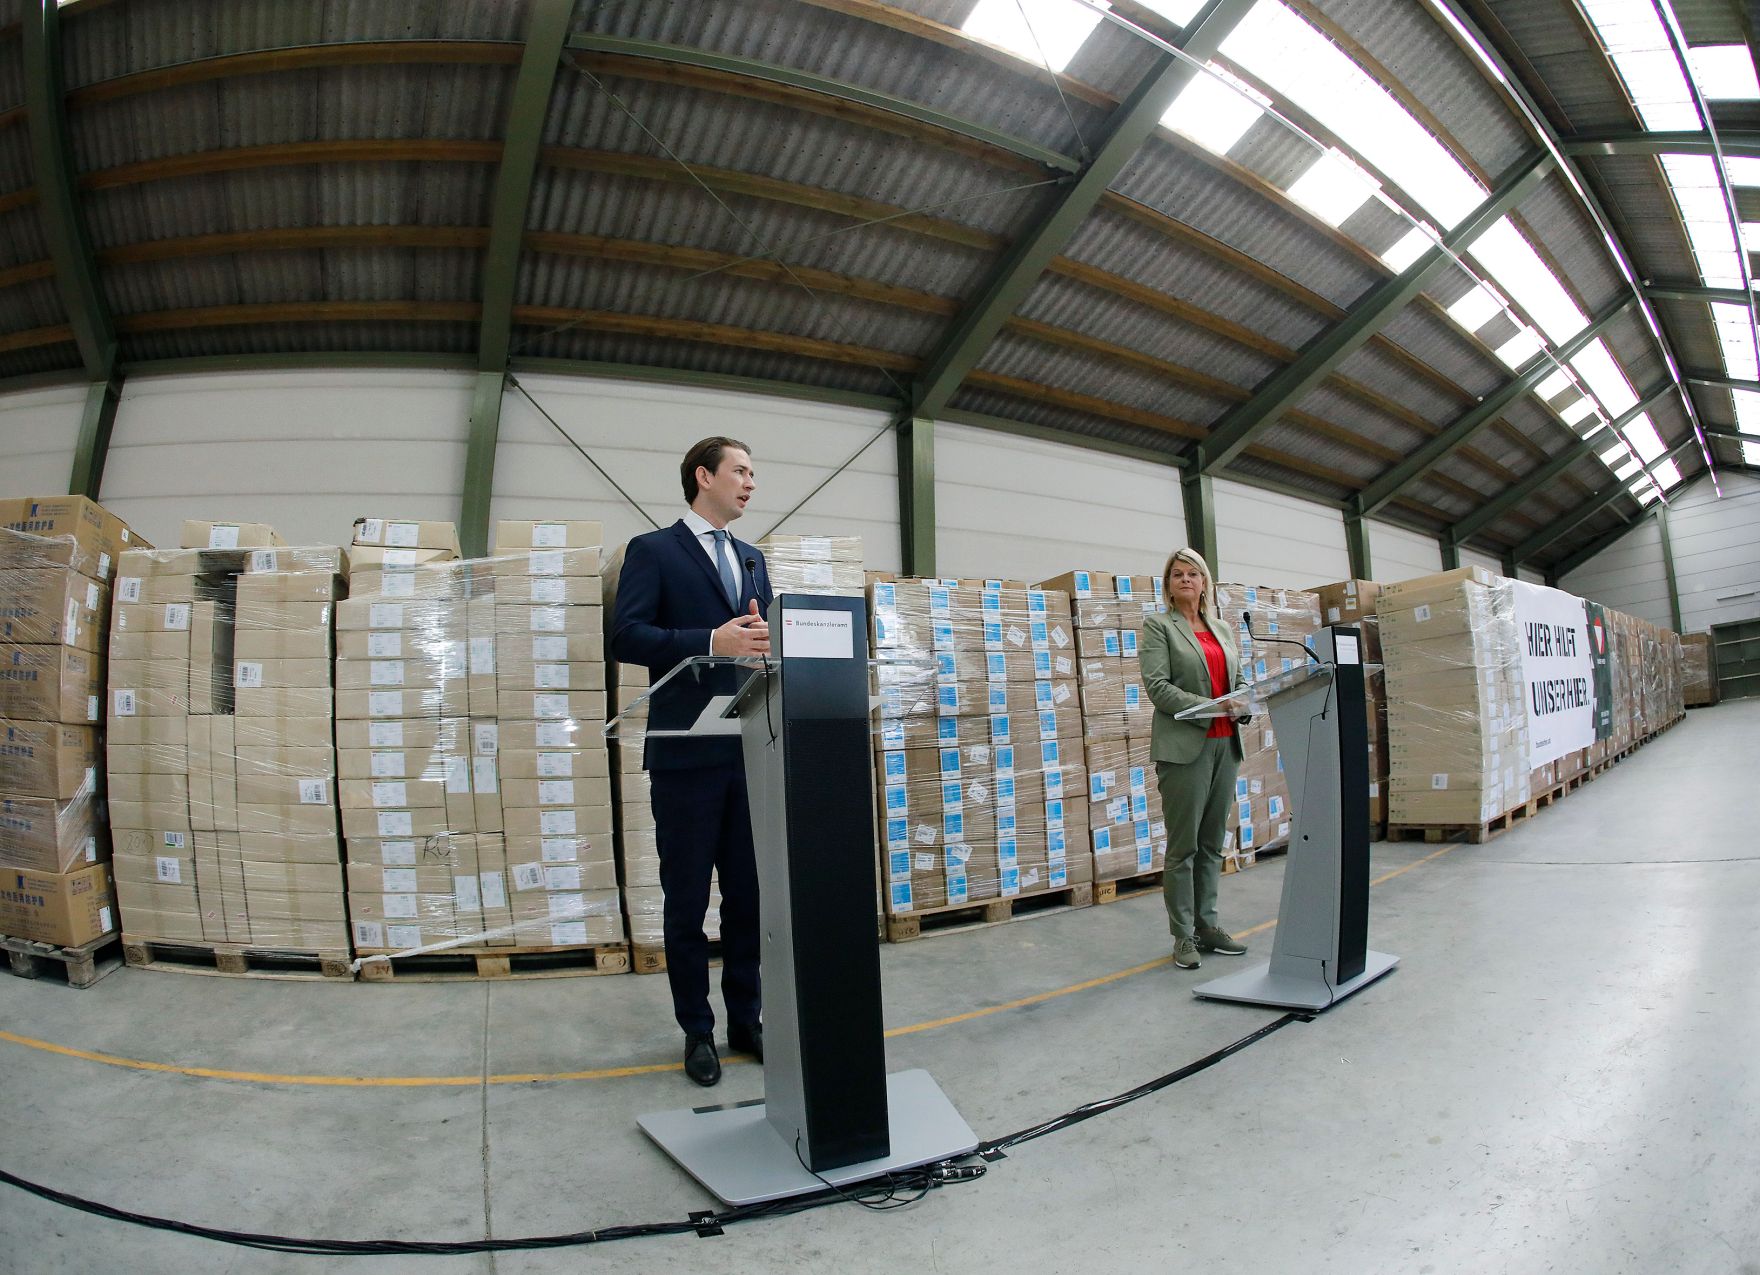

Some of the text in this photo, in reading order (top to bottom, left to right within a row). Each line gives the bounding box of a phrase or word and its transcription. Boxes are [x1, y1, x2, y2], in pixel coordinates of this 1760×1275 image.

[795, 620, 848, 628] Bundeskanzleramt
[1525, 621, 1577, 658] HIER HILFT
[1532, 679, 1566, 717] UNSER
